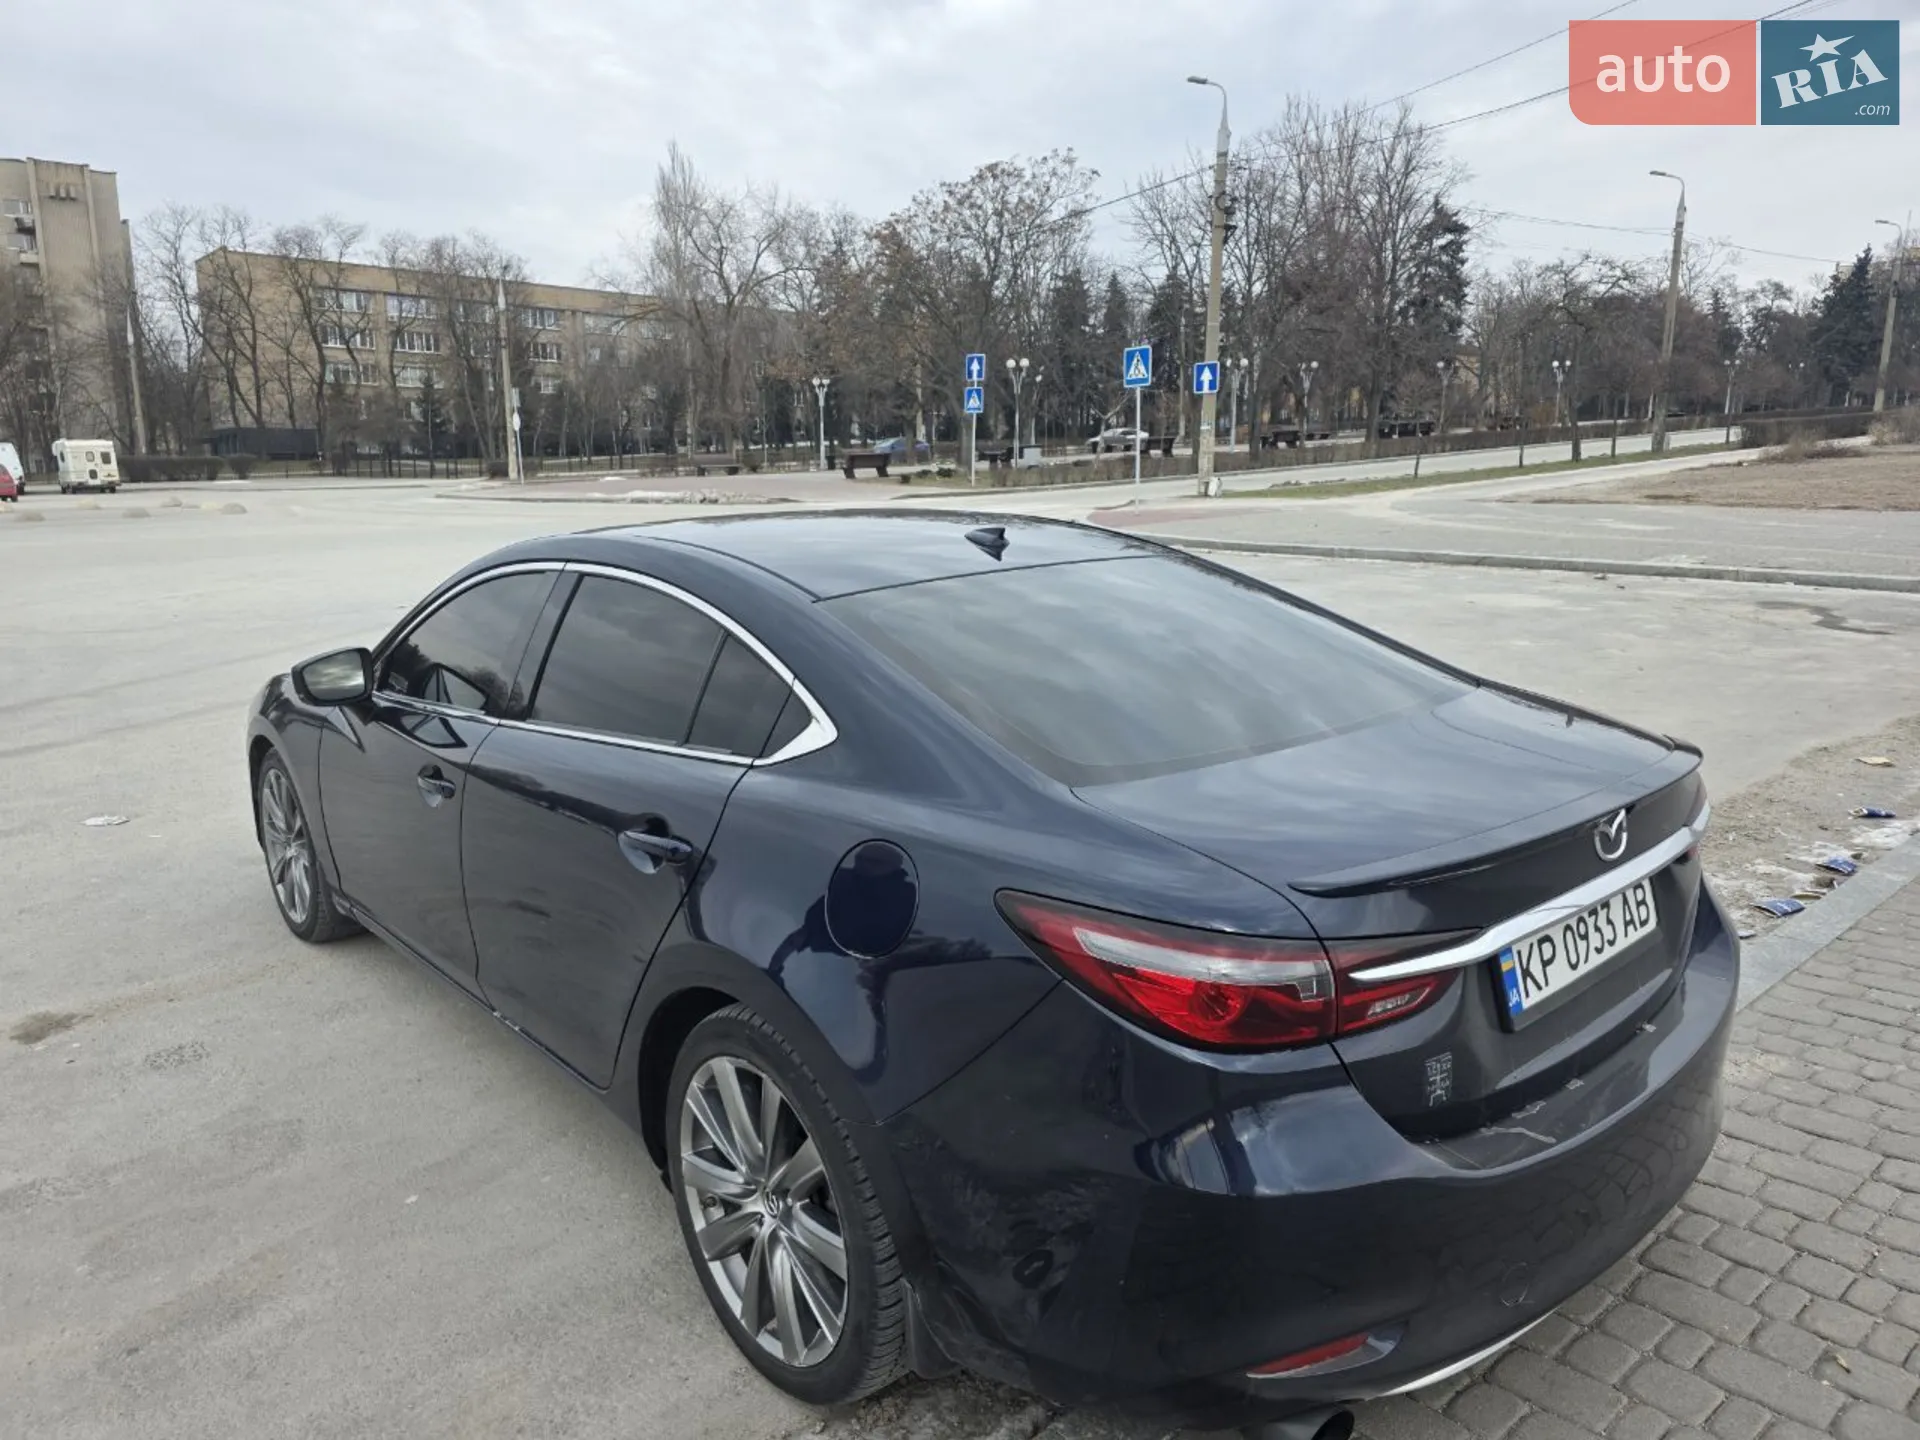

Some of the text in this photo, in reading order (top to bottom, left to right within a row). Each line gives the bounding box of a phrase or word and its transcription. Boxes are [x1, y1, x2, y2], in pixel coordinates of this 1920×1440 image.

[1517, 883, 1650, 998] KP 0933 AB
